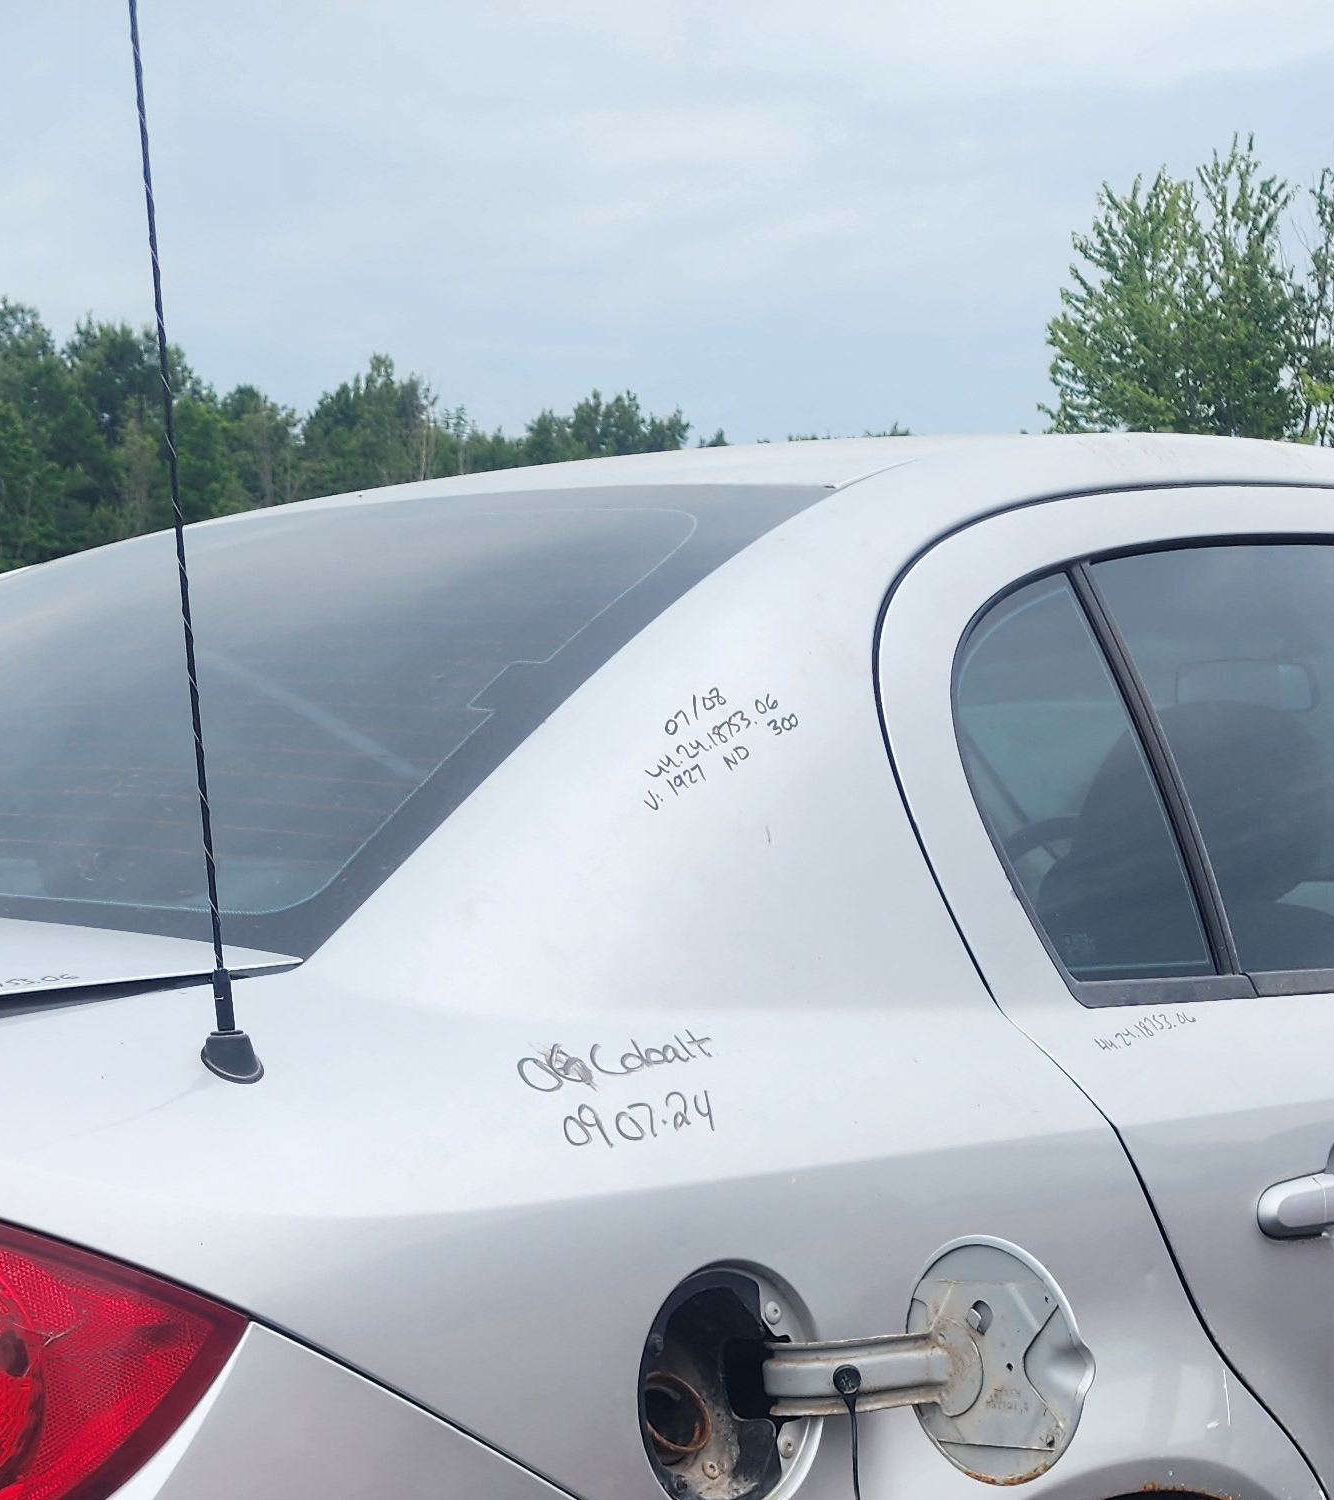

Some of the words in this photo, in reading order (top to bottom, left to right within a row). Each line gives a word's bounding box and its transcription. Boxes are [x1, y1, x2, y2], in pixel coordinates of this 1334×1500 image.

[666, 764, 707, 797] 1927
[766, 713, 799, 736] 300
[589, 1028, 713, 1076] Cobalt
